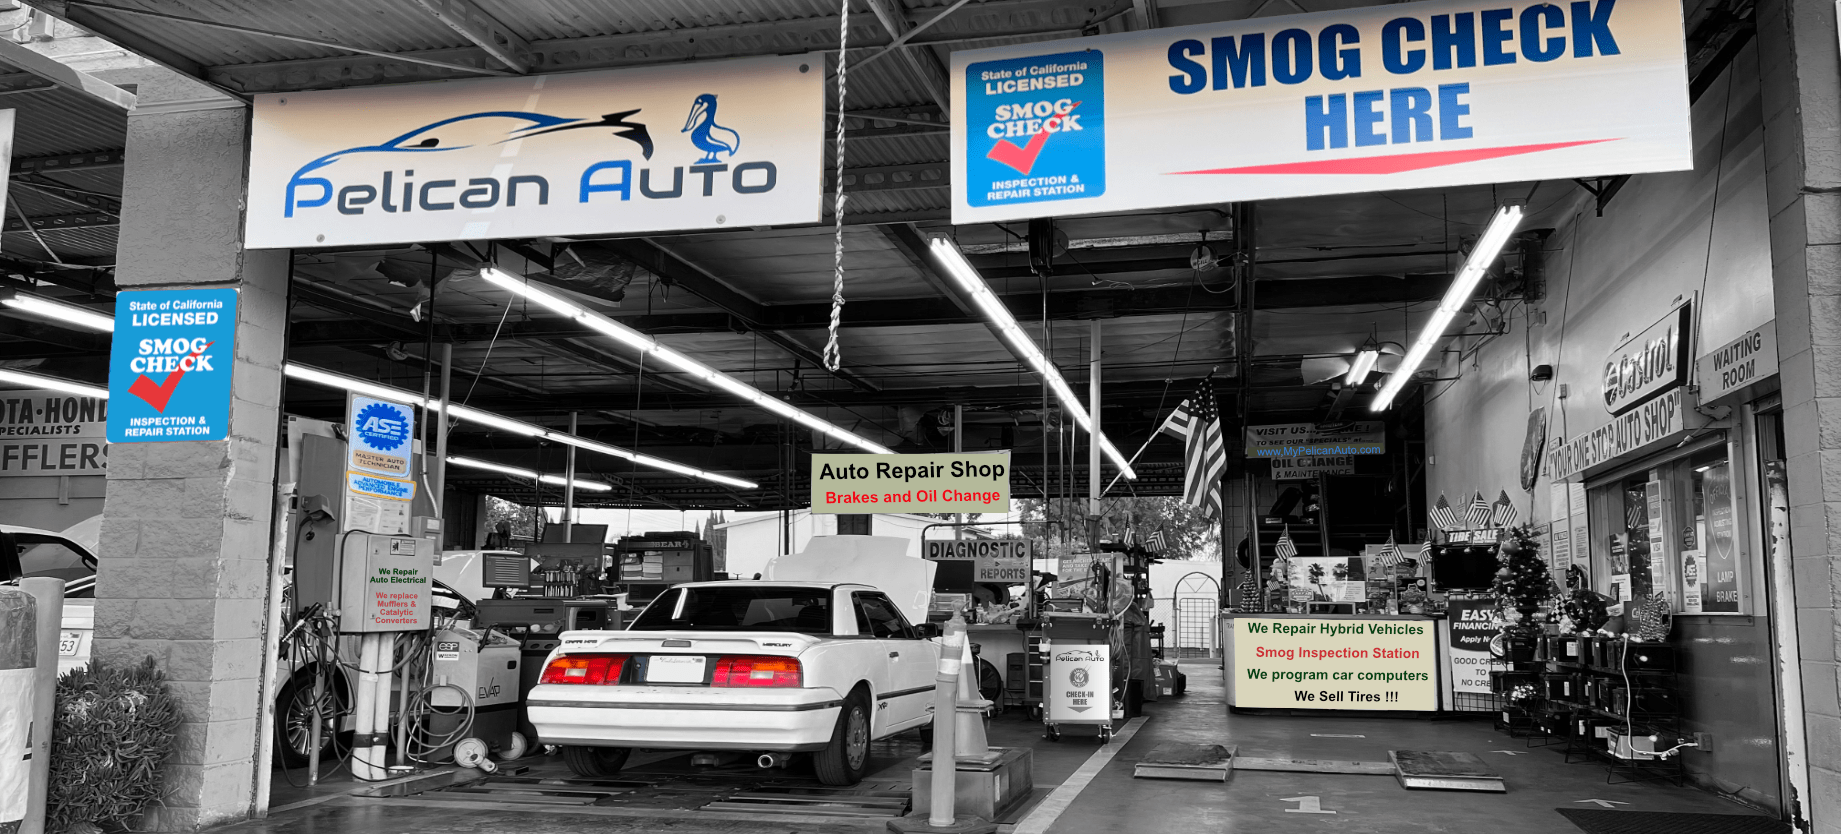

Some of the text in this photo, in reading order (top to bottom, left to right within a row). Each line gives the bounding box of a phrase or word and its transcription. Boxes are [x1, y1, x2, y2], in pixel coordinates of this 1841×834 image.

[1167, 0, 1621, 95] SMOG CHECK
[981, 61, 1088, 81] State of California
[985, 73, 1084, 95] LICENSED
[995, 98, 1074, 121] SMOG
[1304, 82, 1474, 152] HERE
[987, 114, 1083, 139] CHECK
[992, 174, 1080, 190] INSPECTION &
[283, 168, 550, 219] Pelican
[987, 184, 1085, 201] REPAIR STATION
[129, 299, 223, 311] State of California
[132, 312, 219, 327] LICENSED
[138, 337, 208, 355] SMOG
[1713, 331, 1762, 371] WAITING
[130, 355, 214, 373] CHECK
[1618, 324, 1675, 399] Castrol
[1722, 358, 1756, 390] ROOM
[130, 416, 206, 427] INSPECTION &
[362, 416, 402, 435] ASE
[125, 426, 210, 437] REPAIR STATION
[364, 431, 399, 441] CERTIFIED
[1256, 427, 1288, 436] VISIT
[1573, 435, 1590, 472] ONE
[1591, 424, 1614, 463] STOP
[1615, 410, 1641, 456] AUTO
[355, 452, 384, 462] MASTER
[1272, 458, 1294, 469] OIL
[359, 459, 400, 470] TECHNICIAN
[819, 460, 1005, 483] Auto Repair Shop
[826, 489, 1001, 505] Brakes and Oil Change
[1449, 529, 1498, 542] TIRE SALE
[929, 542, 1026, 558] DIAGNOSTIC
[393, 568, 418, 576] Repair
[980, 568, 1026, 579] REPORTS
[1717, 571, 1734, 583] LAMP
[389, 592, 418, 600] replace
[1716, 591, 1738, 603] BRAKE
[377, 600, 417, 608] Mufflers &
[380, 608, 414, 617] Catalytic
[1248, 622, 1269, 634] We
[1273, 622, 1316, 636] Repair
[1320, 623, 1364, 637] Hybrid
[1368, 623, 1424, 635] Vehicles
[1453, 622, 1500, 630] FINANCIN
[60, 639, 75, 652] 53
[1460, 636, 1481, 645] Apply
[1256, 646, 1420, 660] Smog Inspection Station
[1454, 657, 1477, 665] GOOD
[1247, 668, 1429, 683] We program car computers
[1461, 678, 1473, 686] NO
[478, 676, 501, 700] EVAP
[1294, 690, 1399, 702] We Sell Tires !!!
